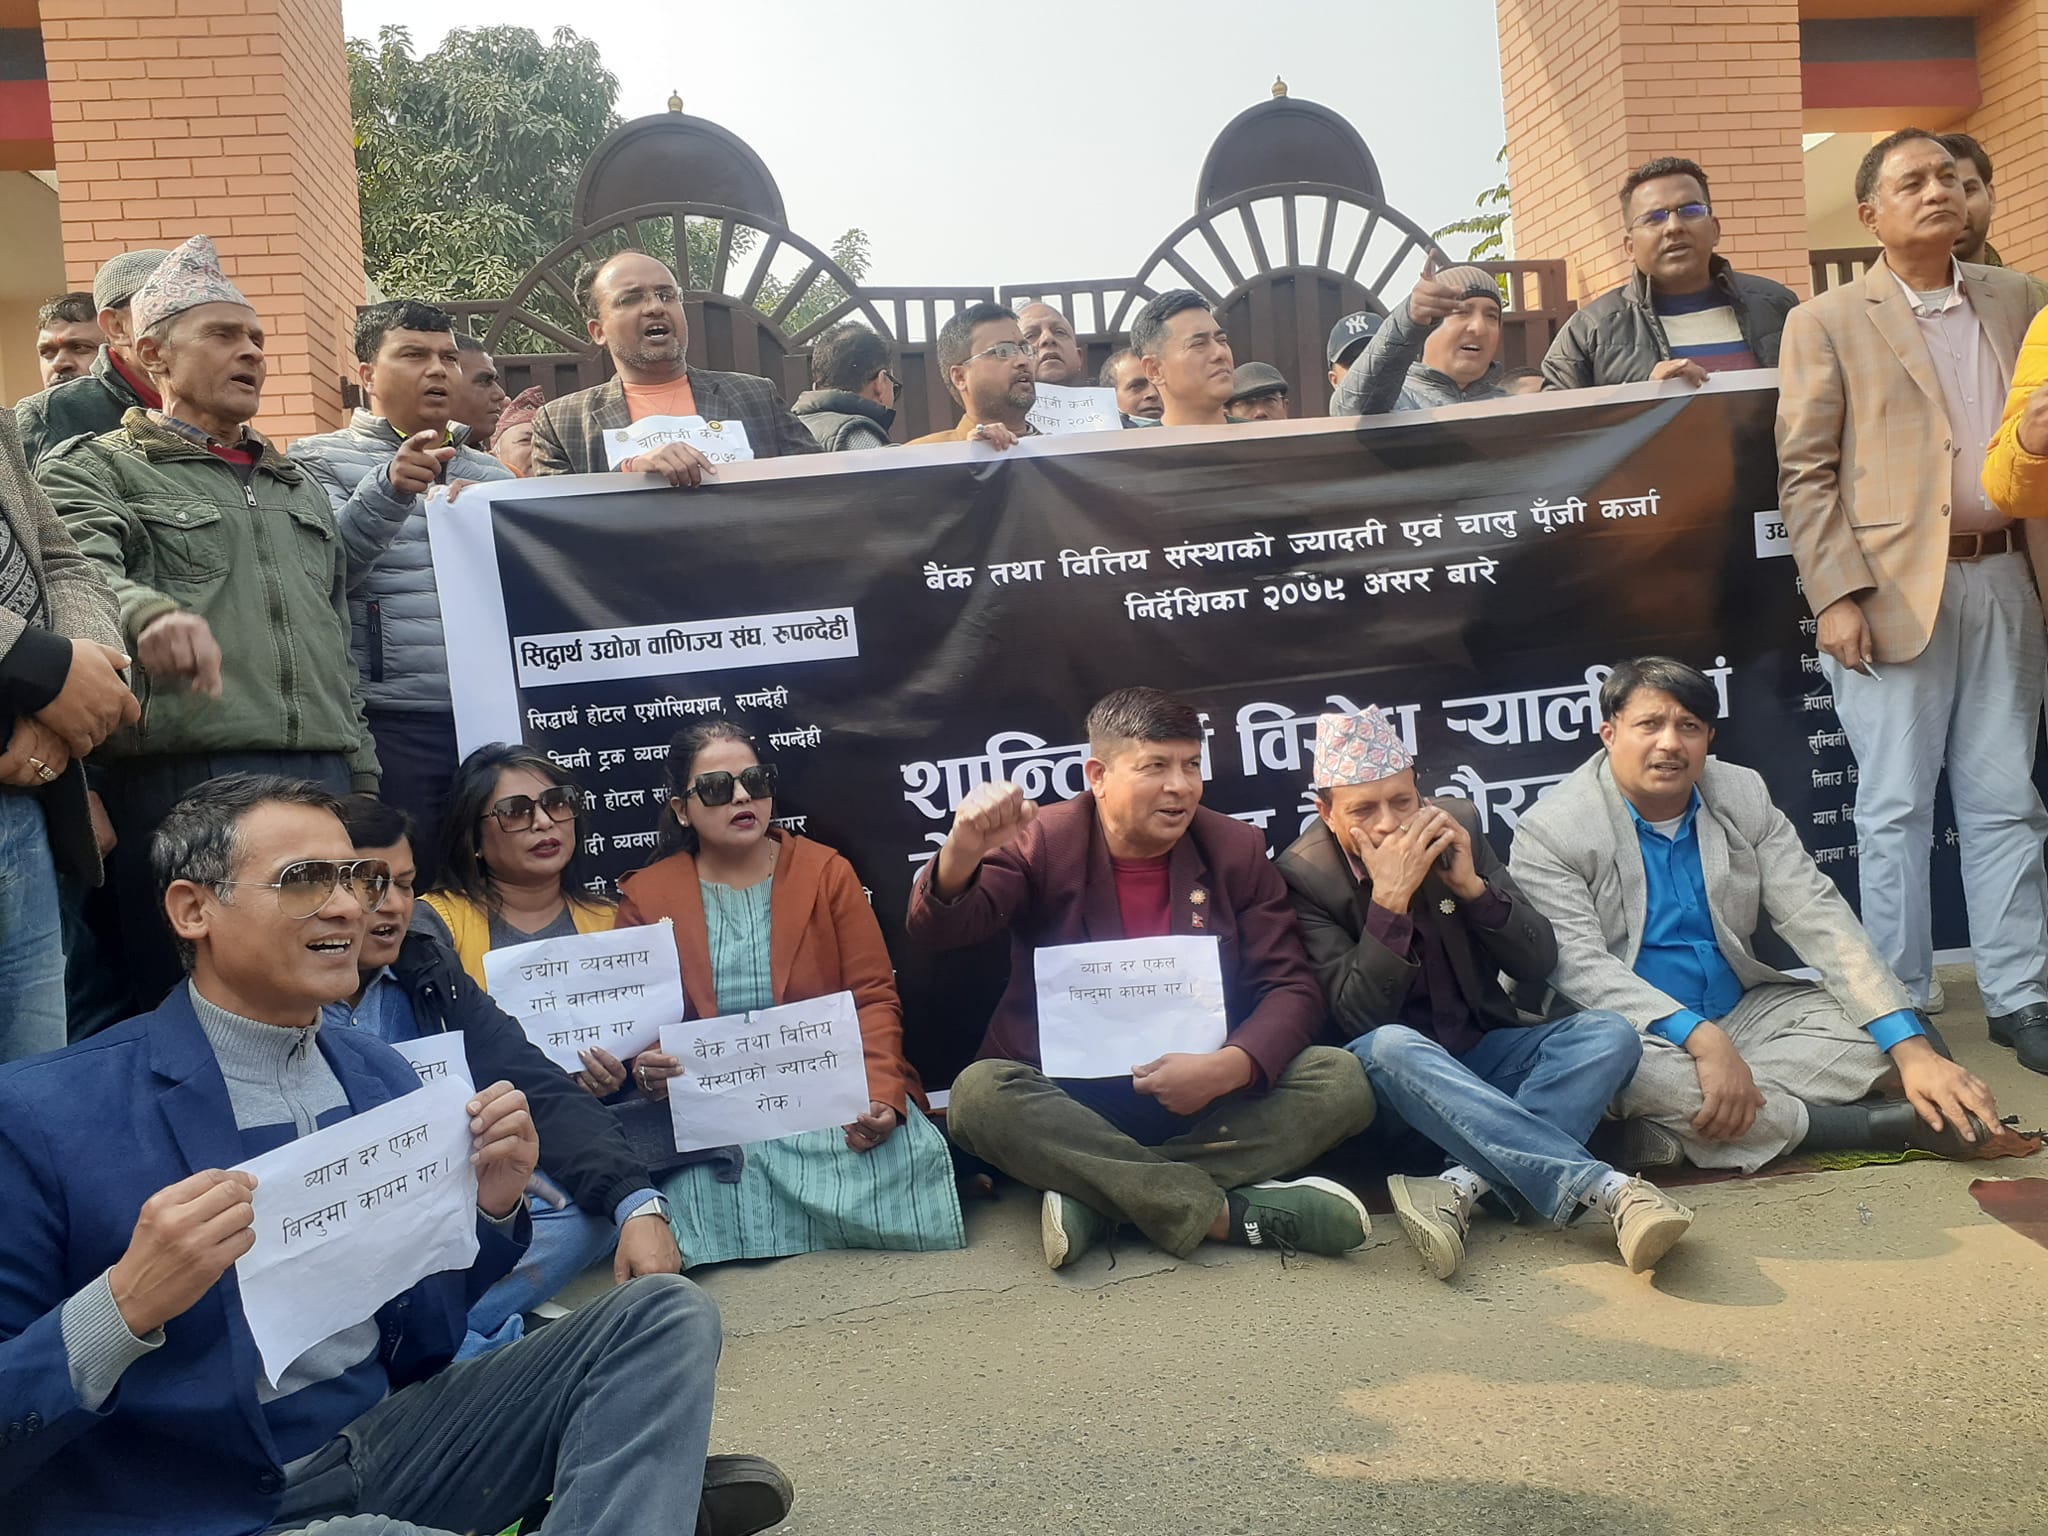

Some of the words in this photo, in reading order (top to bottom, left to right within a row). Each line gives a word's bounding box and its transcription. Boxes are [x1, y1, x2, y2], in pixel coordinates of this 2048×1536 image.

[1345, 315, 1369, 335] NY
[923, 561, 976, 591] बैंक
[988, 559, 1046, 586] तथा
[1057, 546, 1151, 578] वित्तिय
[1163, 531, 1275, 569] संस्थाको
[1287, 518, 1387, 554] ज्यादती
[1400, 513, 1443, 547] एवं
[1455, 509, 1518, 539] चालु
[1530, 497, 1588, 533] पूँजी
[1599, 488, 1661, 520] कर्जा
[1124, 588, 1250, 621] निर्देशिका
[1262, 577, 1347, 610] २०७९
[1363, 567, 1434, 595] असर
[1446, 555, 1500, 585] बारे
[588, 634, 641, 661] उद्योग
[647, 629, 723, 655] वाणिज्य
[772, 614, 849, 645] रूपन्देही
[527, 705, 578, 731] सिद्धार्थ
[585, 704, 627, 727] होटल
[735, 685, 788, 713] रुपन्देही
[769, 724, 822, 751] रुपन्देही
[598, 749, 626, 772] ट्रक
[604, 789, 645, 811] होटल
[520, 957, 570, 981] उद्योग
[579, 950, 650, 971] व्यवसाय
[1119, 960, 1136, 972] दर
[1143, 957, 1177, 973] एकल
[566, 983, 645, 1007] वातावरण
[1118, 984, 1157, 999] कायम
[1163, 982, 1183, 995] गर
[546, 1025, 601, 1047] कायम
[610, 1020, 635, 1037] गर
[735, 1033, 771, 1054] तथा
[779, 1021, 832, 1046] वित्तिय
[776, 1050, 839, 1075] ज्यादती
[755, 1092, 789, 1113] रोक
[358, 1144, 380, 1168] दर
[388, 1123, 429, 1158] एकल
[357, 1174, 409, 1211] कायम
[416, 1161, 439, 1184] गर
[1244, 1221, 1264, 1246] NIKE
